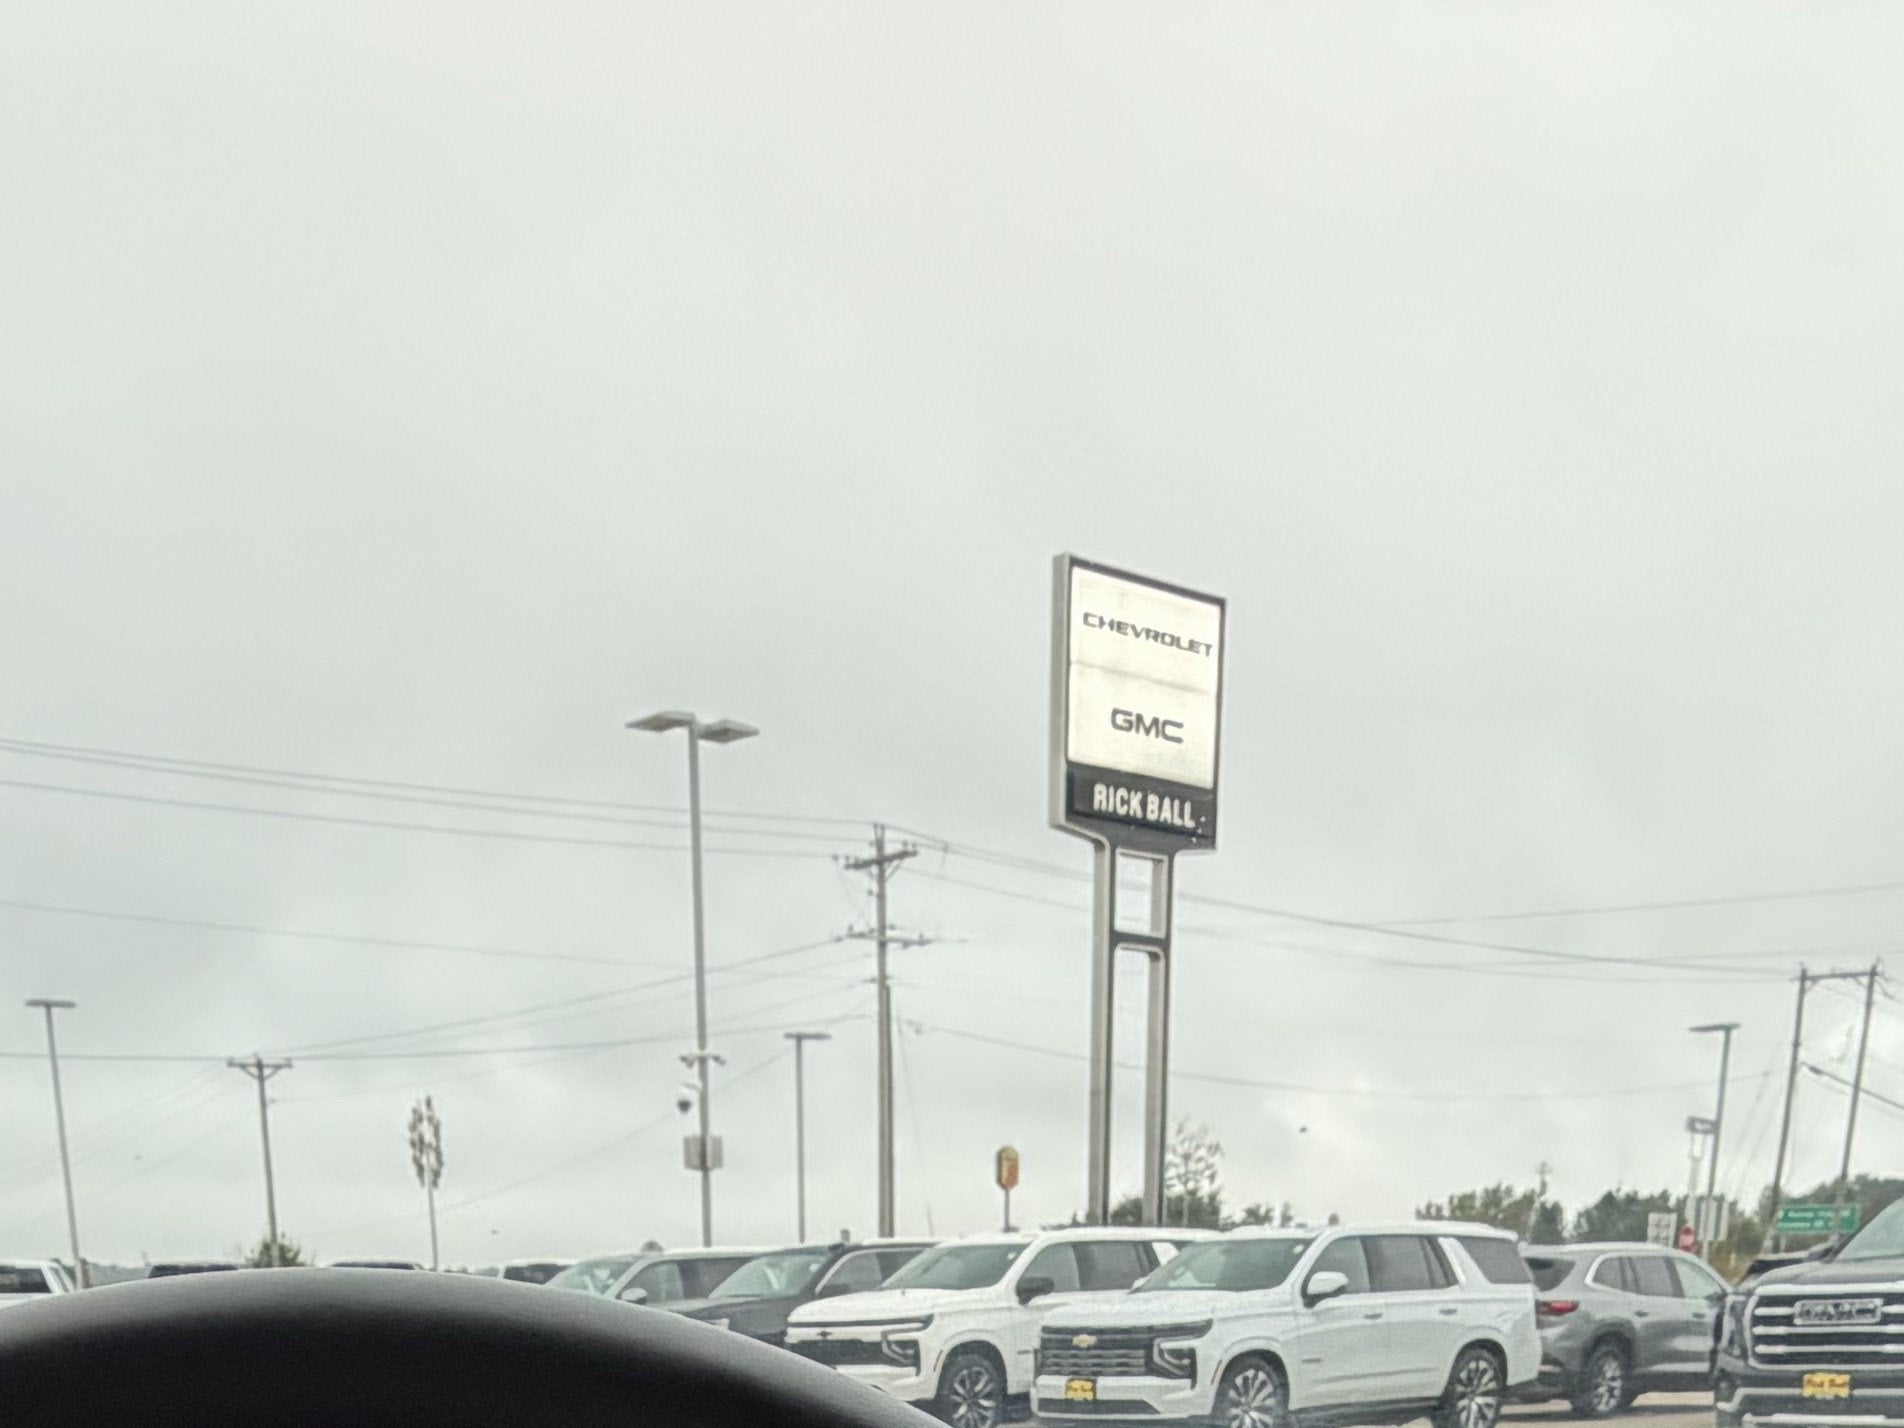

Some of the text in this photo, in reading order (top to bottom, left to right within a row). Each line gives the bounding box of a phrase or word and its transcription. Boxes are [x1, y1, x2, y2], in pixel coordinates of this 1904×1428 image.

[1082, 611, 1213, 657] CHEVROLET
[1110, 707, 1185, 745] GMC
[1093, 782, 1196, 829] RICK BALL
